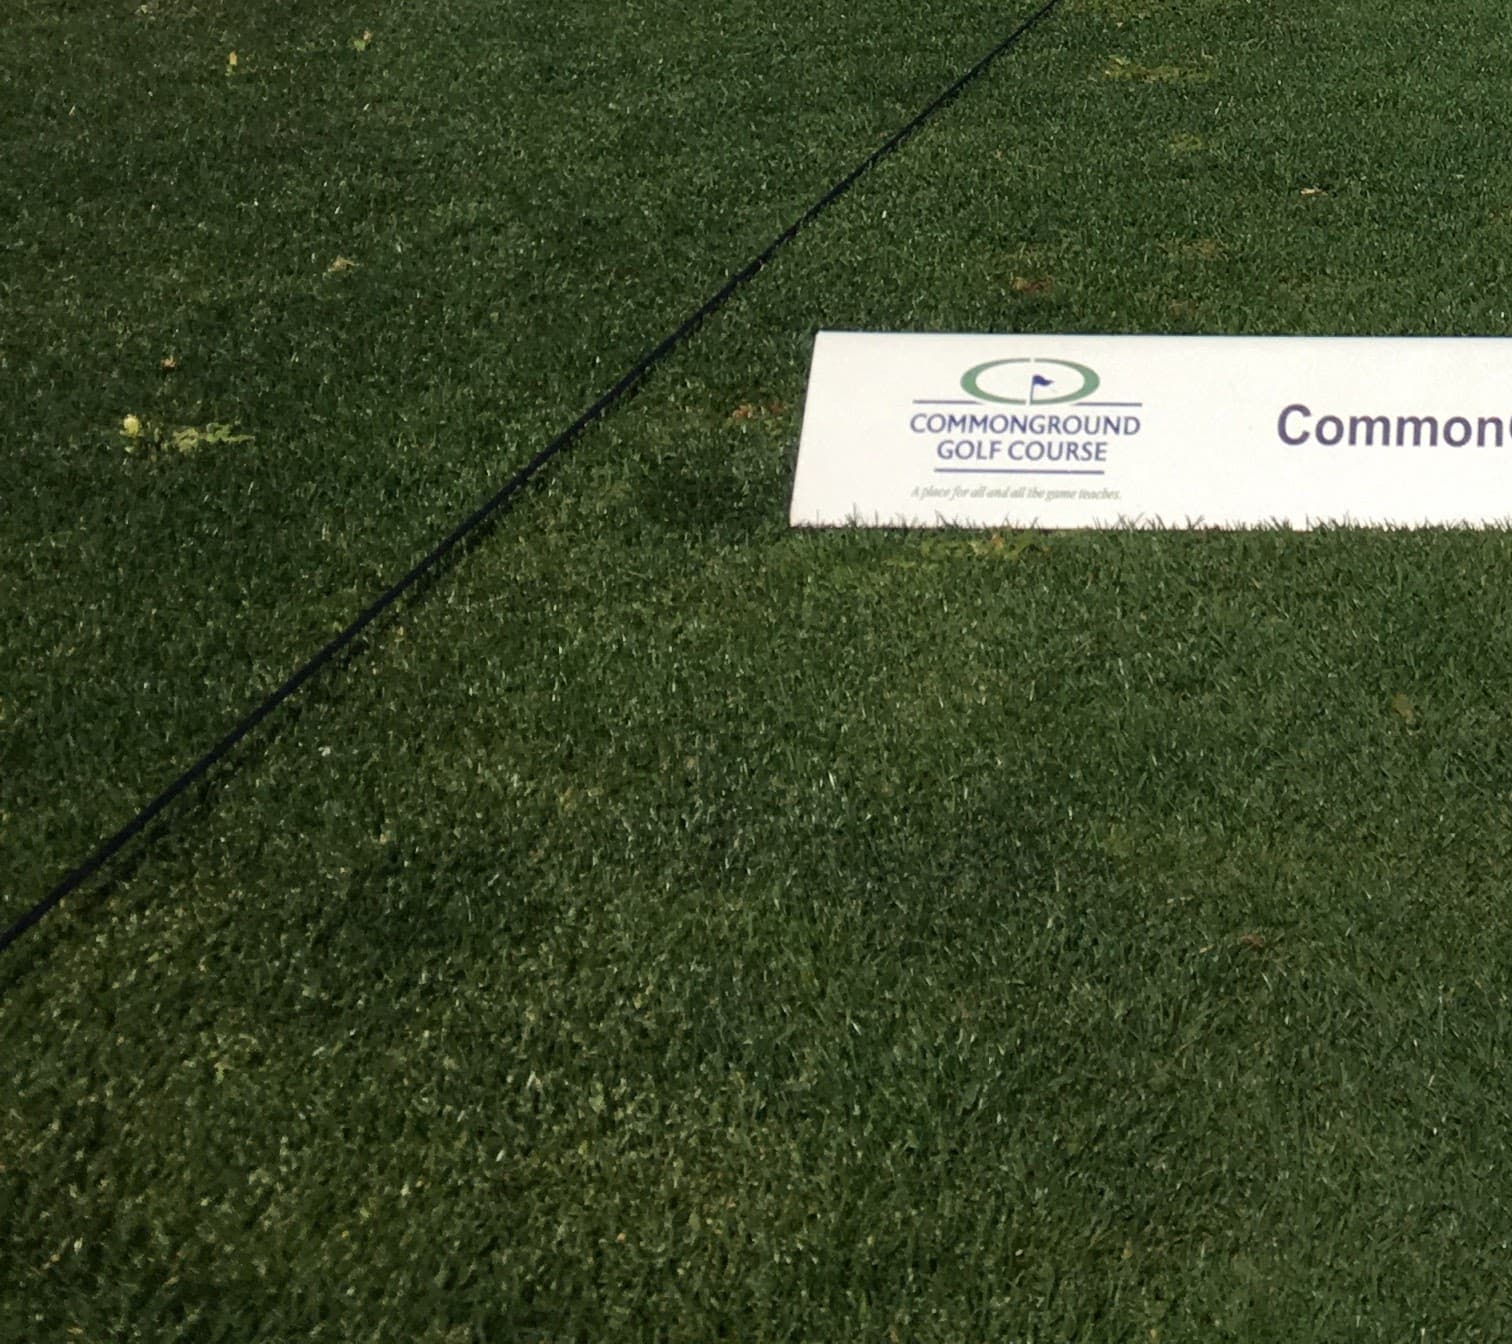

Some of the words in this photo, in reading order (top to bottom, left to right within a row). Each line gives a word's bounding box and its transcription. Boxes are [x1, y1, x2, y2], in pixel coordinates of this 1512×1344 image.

[910, 413, 1141, 436] COMMONGROUND
[937, 439, 1002, 461] GOLF
[1007, 440, 1108, 462] COURSE
[911, 486, 921, 498] A
[921, 485, 949, 500] place
[949, 486, 968, 501] for
[970, 486, 985, 499] all
[986, 486, 1007, 499] and
[1010, 486, 1025, 499] all
[1026, 487, 1045, 499] the
[1046, 490, 1077, 502] game
